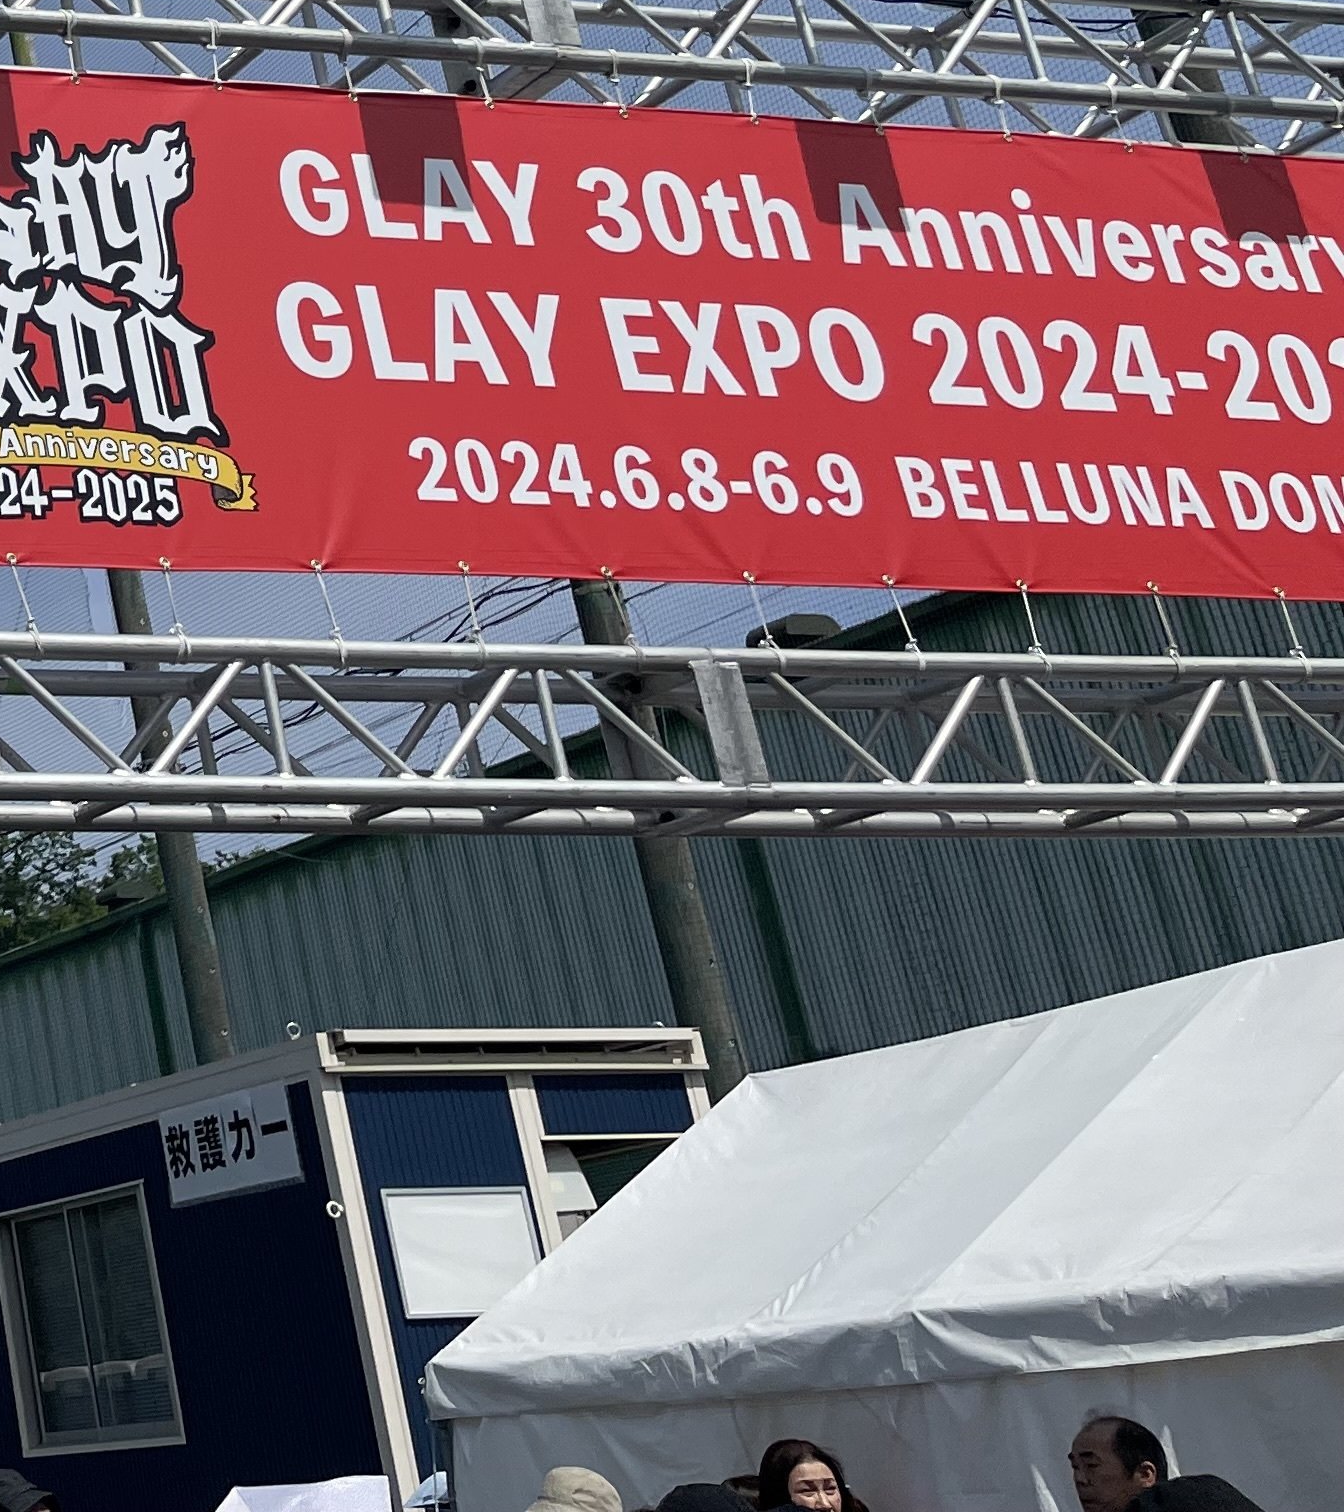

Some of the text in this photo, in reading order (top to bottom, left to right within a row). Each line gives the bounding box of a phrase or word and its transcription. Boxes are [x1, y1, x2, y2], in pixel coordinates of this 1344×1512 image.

[278, 148, 539, 248] GLAY
[576, 165, 811, 262] 30th
[275, 281, 560, 389] GLAY
[598, 296, 886, 404] EXPO
[406, 435, 865, 520] 2024.6.8-6.9
[893, 454, 1217, 530] BELLUNA
[164, 1109, 289, 1179] 救護カー
